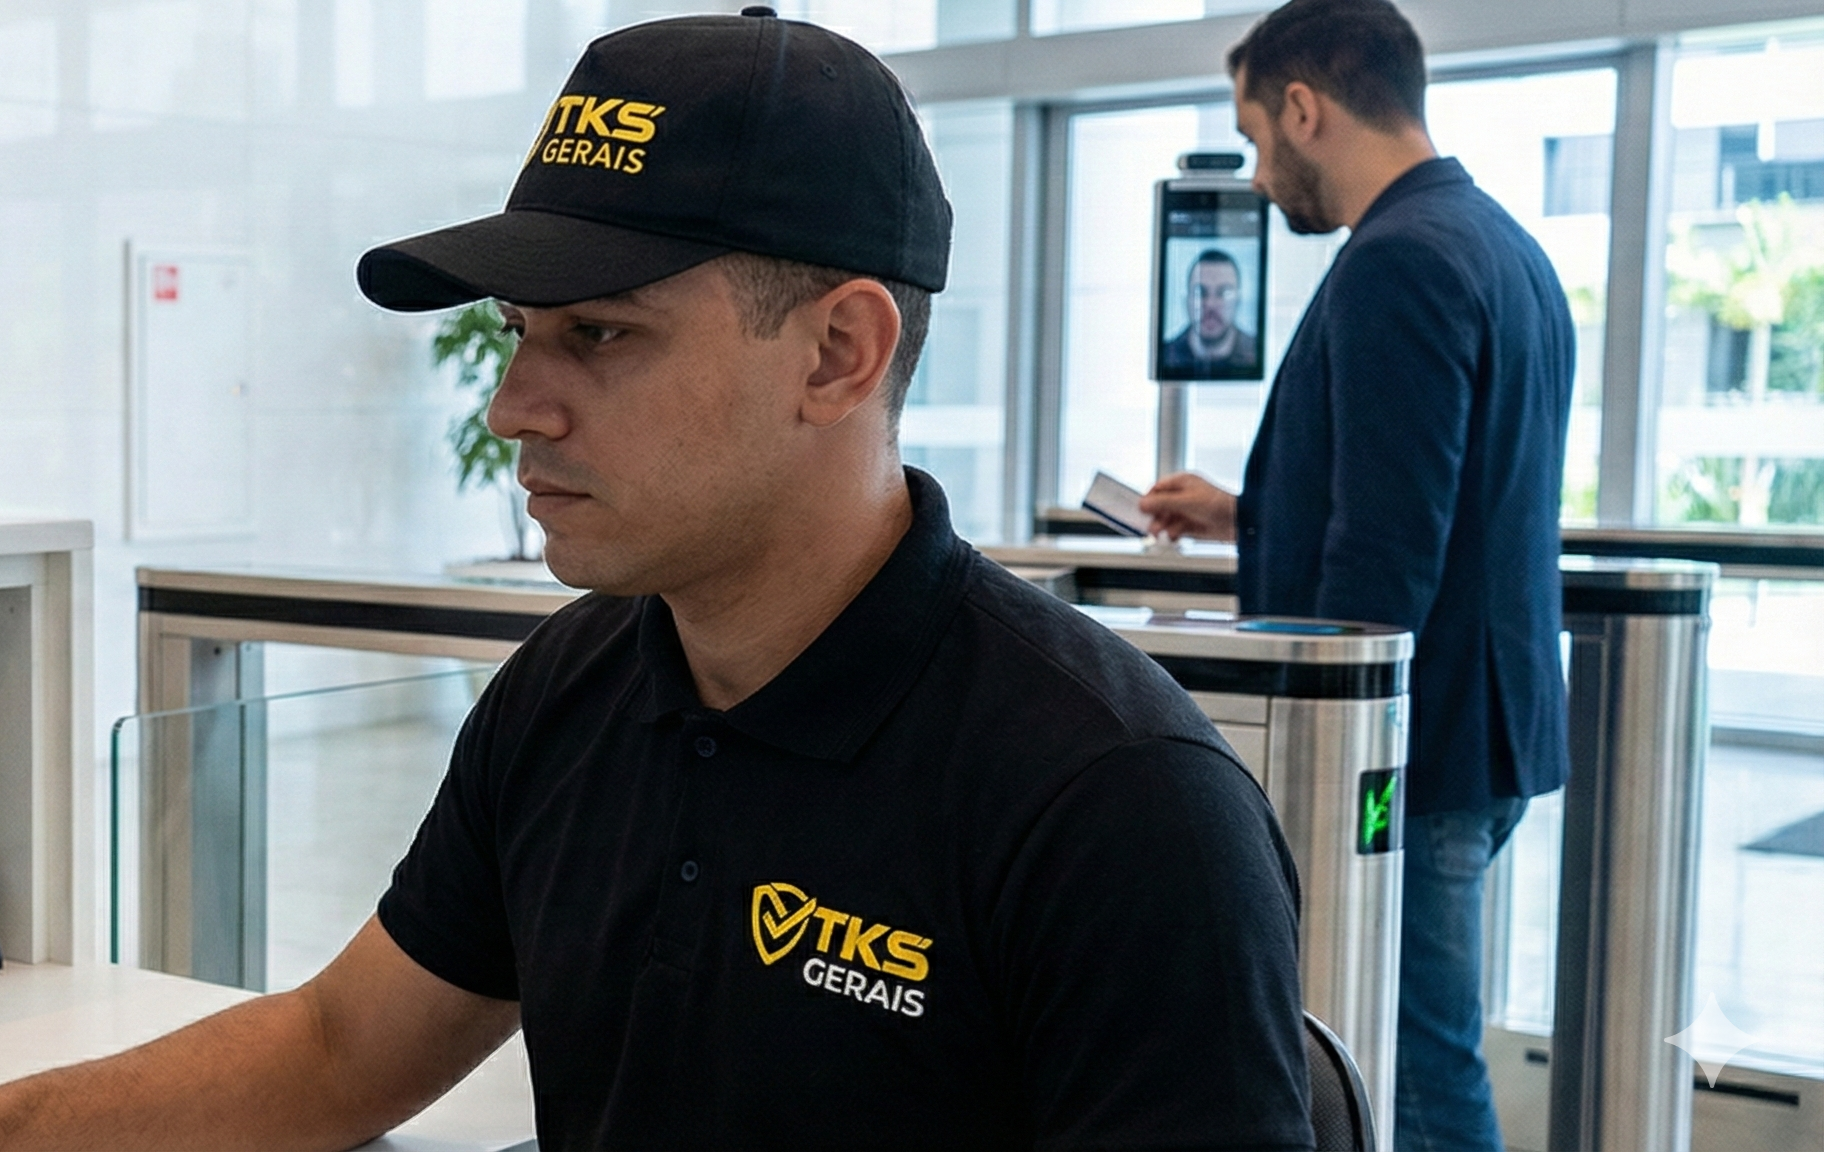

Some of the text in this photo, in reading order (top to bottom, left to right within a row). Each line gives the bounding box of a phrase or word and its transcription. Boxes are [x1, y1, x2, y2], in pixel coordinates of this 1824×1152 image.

[554, 95, 666, 143] TKS
[542, 138, 646, 174] GERAIS
[813, 906, 933, 982] TKS
[802, 957, 926, 1018] GERAIS
